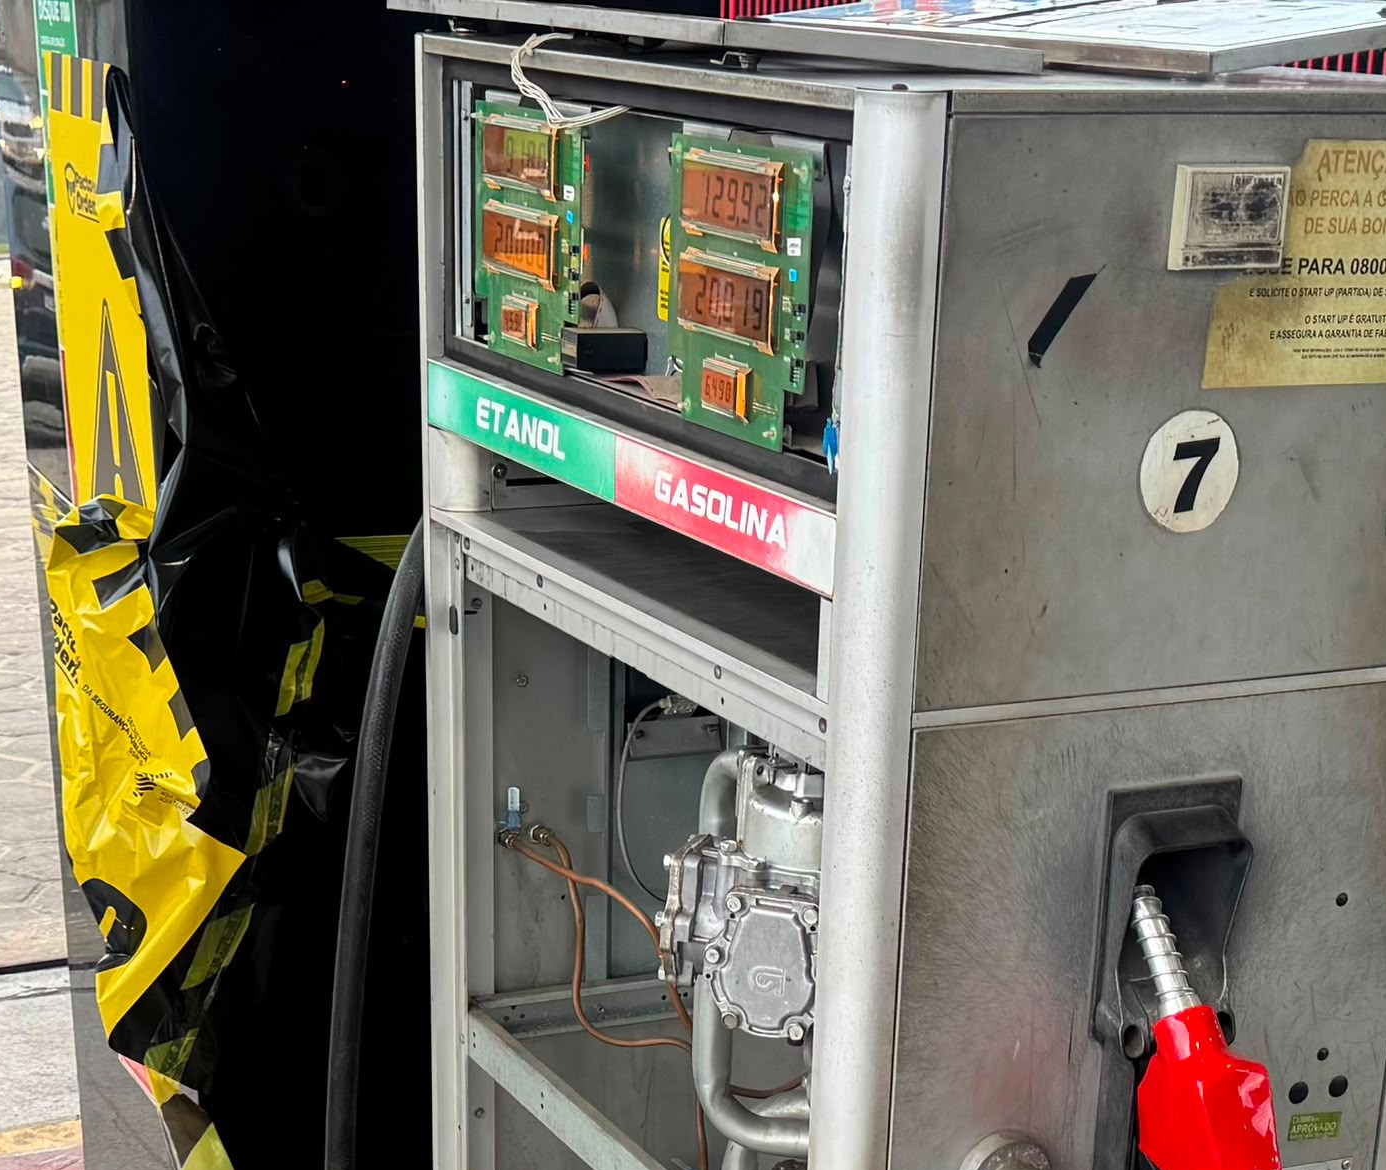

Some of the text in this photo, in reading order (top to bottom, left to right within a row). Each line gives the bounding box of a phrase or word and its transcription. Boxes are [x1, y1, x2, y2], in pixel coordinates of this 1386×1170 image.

[703, 172, 769, 230] 129,92
[1311, 190, 1359, 207] PERCA
[1363, 191, 1373, 207] A
[1305, 217, 1324, 234] DE
[1328, 217, 1358, 234] SUA
[1298, 258, 1345, 275] PARA
[1256, 288, 1291, 297] SOLICITE
[1299, 287, 1323, 297] START
[1324, 287, 1335, 297] UP
[1373, 287, 1384, 297] DE
[1313, 314, 1337, 324] START
[1337, 314, 1348, 324] UP
[1276, 330, 1317, 339] ASSEGURA
[1324, 329, 1363, 339] GARANTIA
[1363, 329, 1374, 339] DE
[476, 396, 565, 461] ETANOL
[1173, 437, 1221, 514] 7
[654, 470, 788, 550] GASOLINA
[91, 694, 130, 736] SEGURANÇA
[1291, 1121, 1337, 1134] APROVADO
